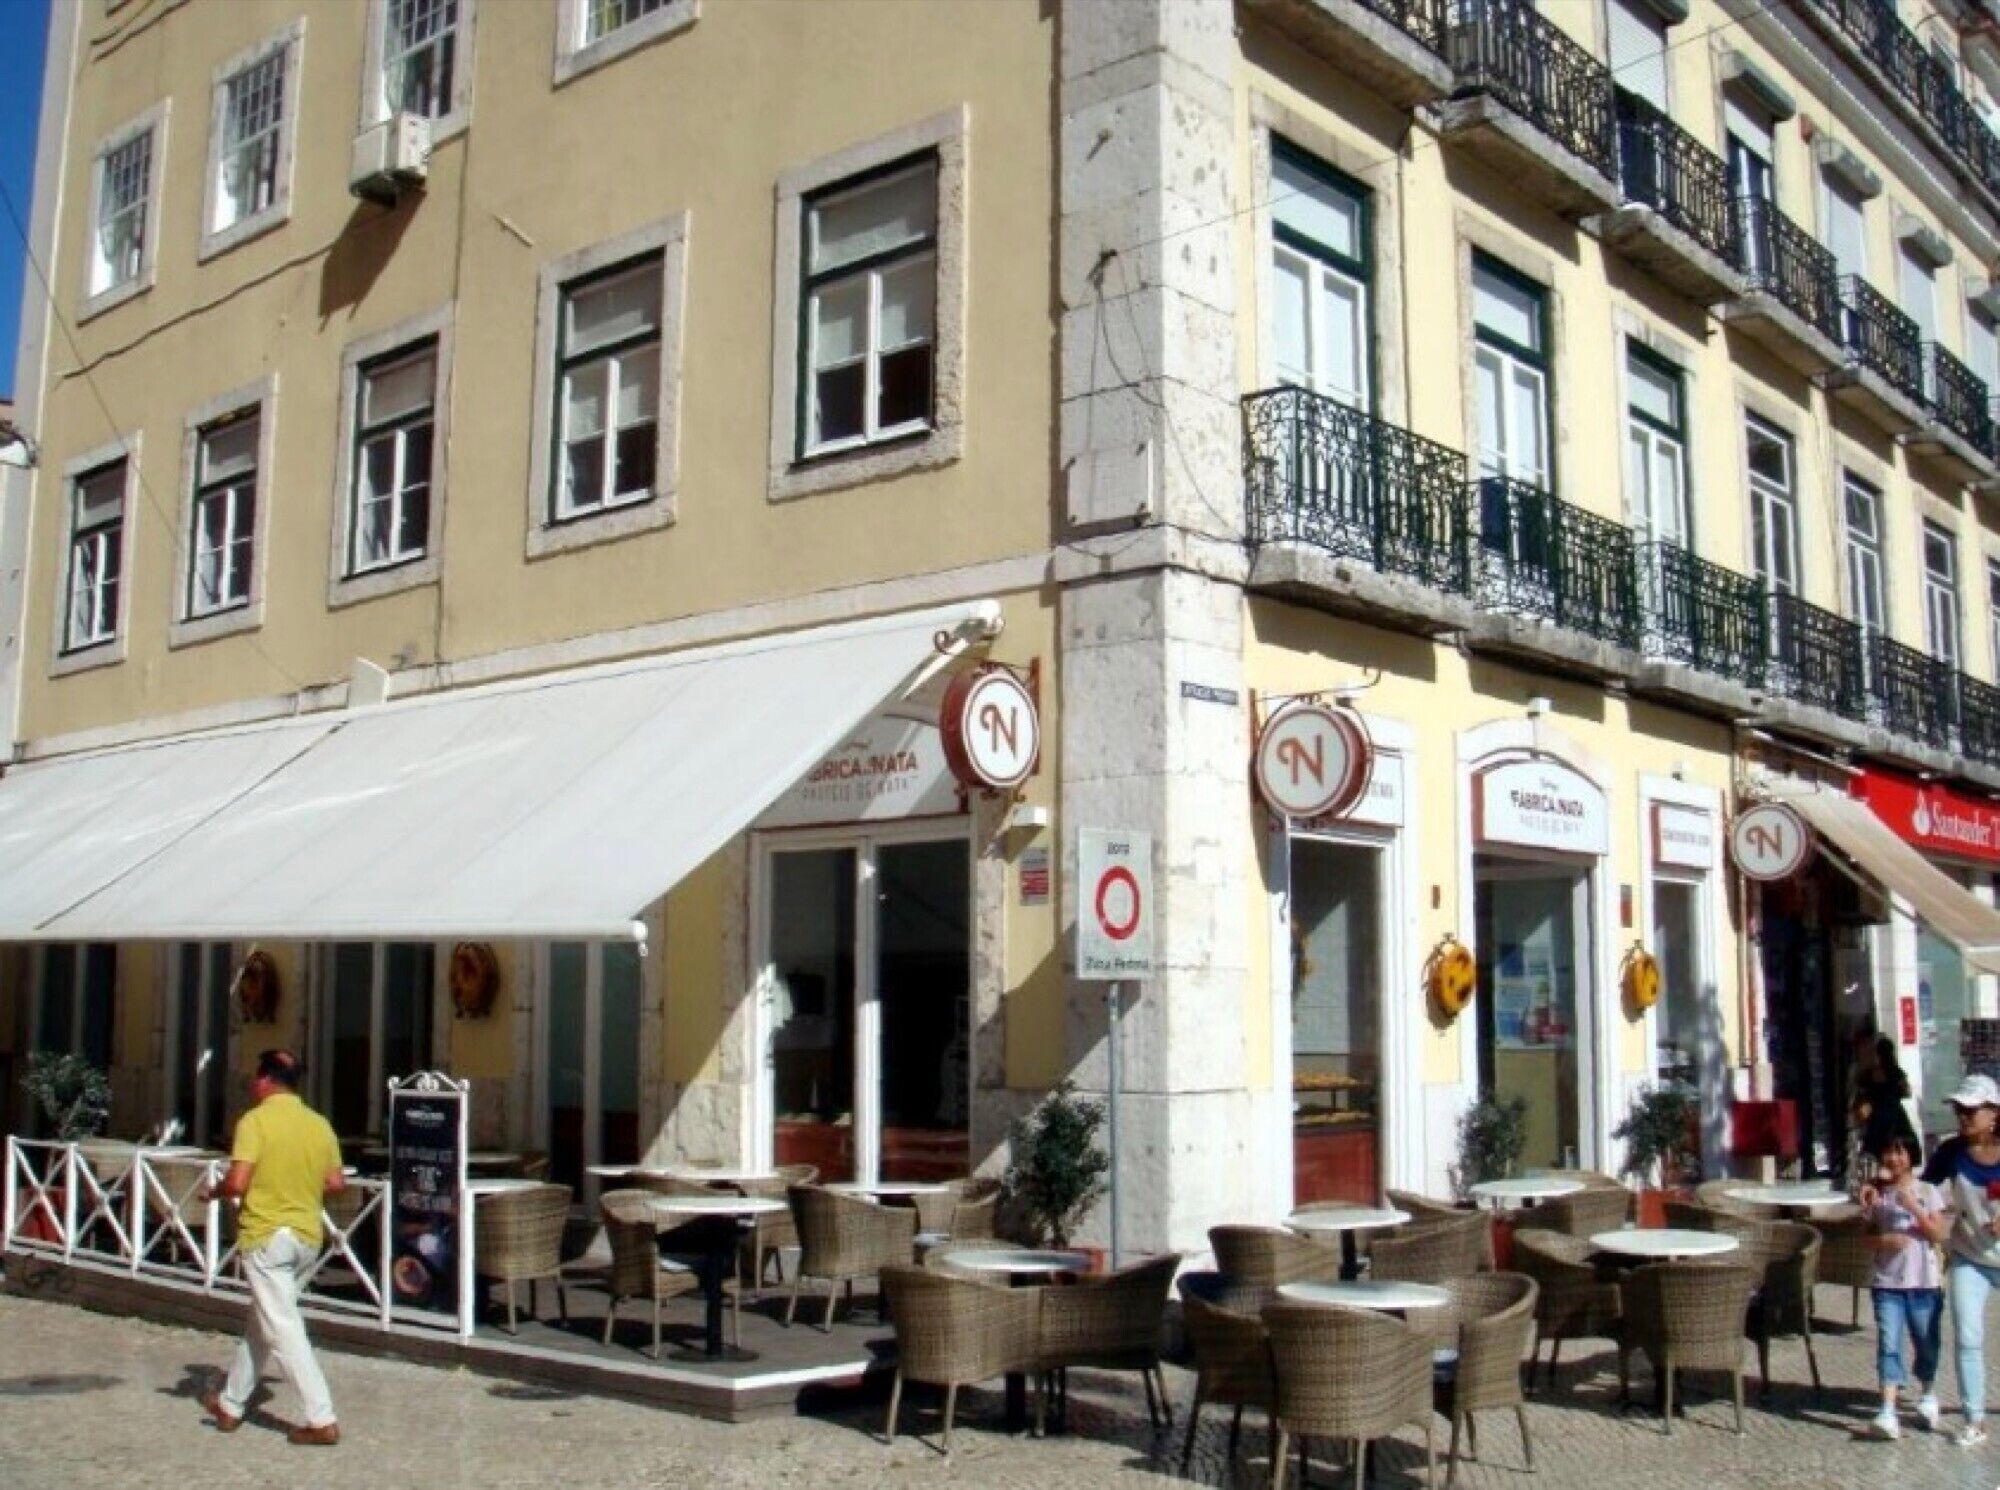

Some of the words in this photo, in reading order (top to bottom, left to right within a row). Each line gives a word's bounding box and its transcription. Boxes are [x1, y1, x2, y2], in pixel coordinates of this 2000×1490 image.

[979, 703, 1020, 760] N
[1276, 734, 1325, 787] N
[1745, 823, 1785, 861] N
[1932, 800, 1990, 847] Santander
